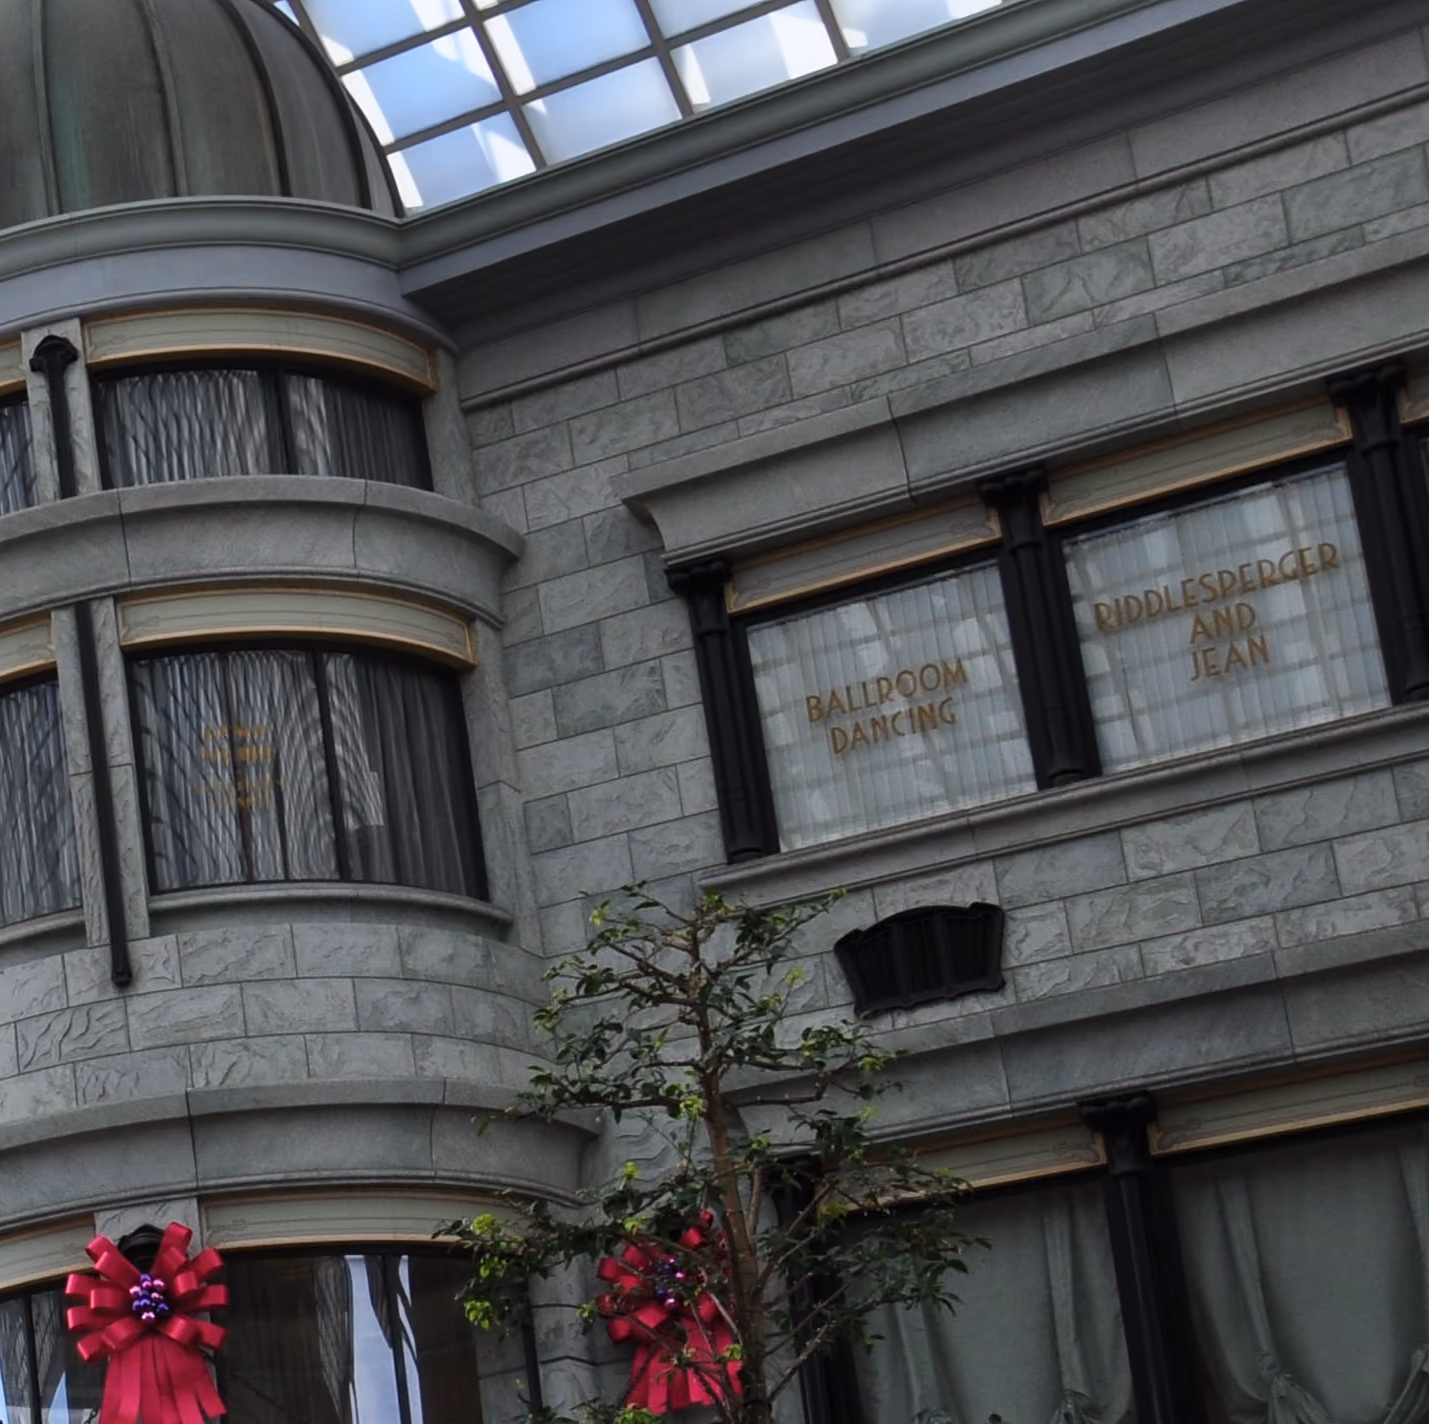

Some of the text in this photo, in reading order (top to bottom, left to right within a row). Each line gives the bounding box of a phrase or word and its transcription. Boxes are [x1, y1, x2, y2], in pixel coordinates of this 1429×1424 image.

[1094, 543, 1339, 632] RIDDLESPERGER
[1190, 602, 1256, 644] AND
[1191, 635, 1270, 681] JEAN
[806, 658, 968, 723] BALLROOM
[831, 697, 956, 754] DANCING
